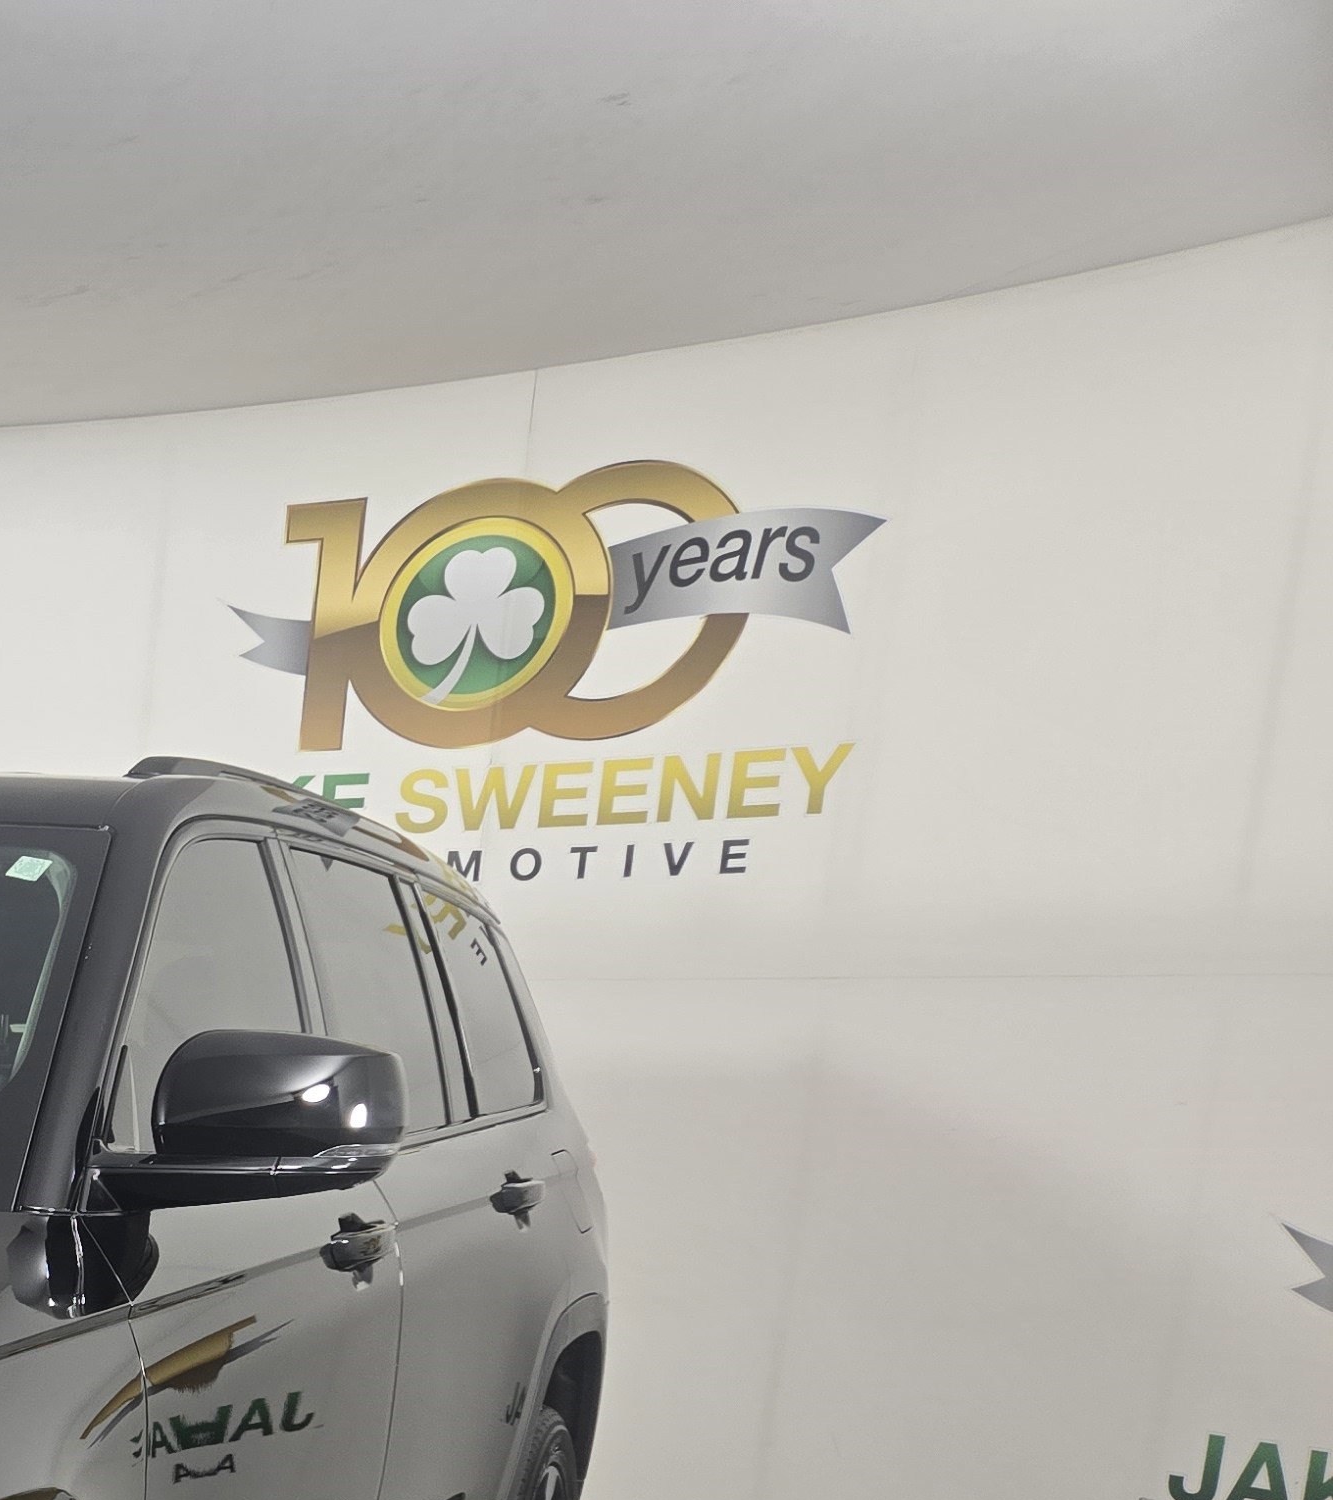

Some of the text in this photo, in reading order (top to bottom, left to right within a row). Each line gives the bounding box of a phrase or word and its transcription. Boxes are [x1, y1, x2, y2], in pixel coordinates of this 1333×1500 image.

[286, 460, 820, 752] 100 years
[394, 743, 855, 834] SWEENEY
